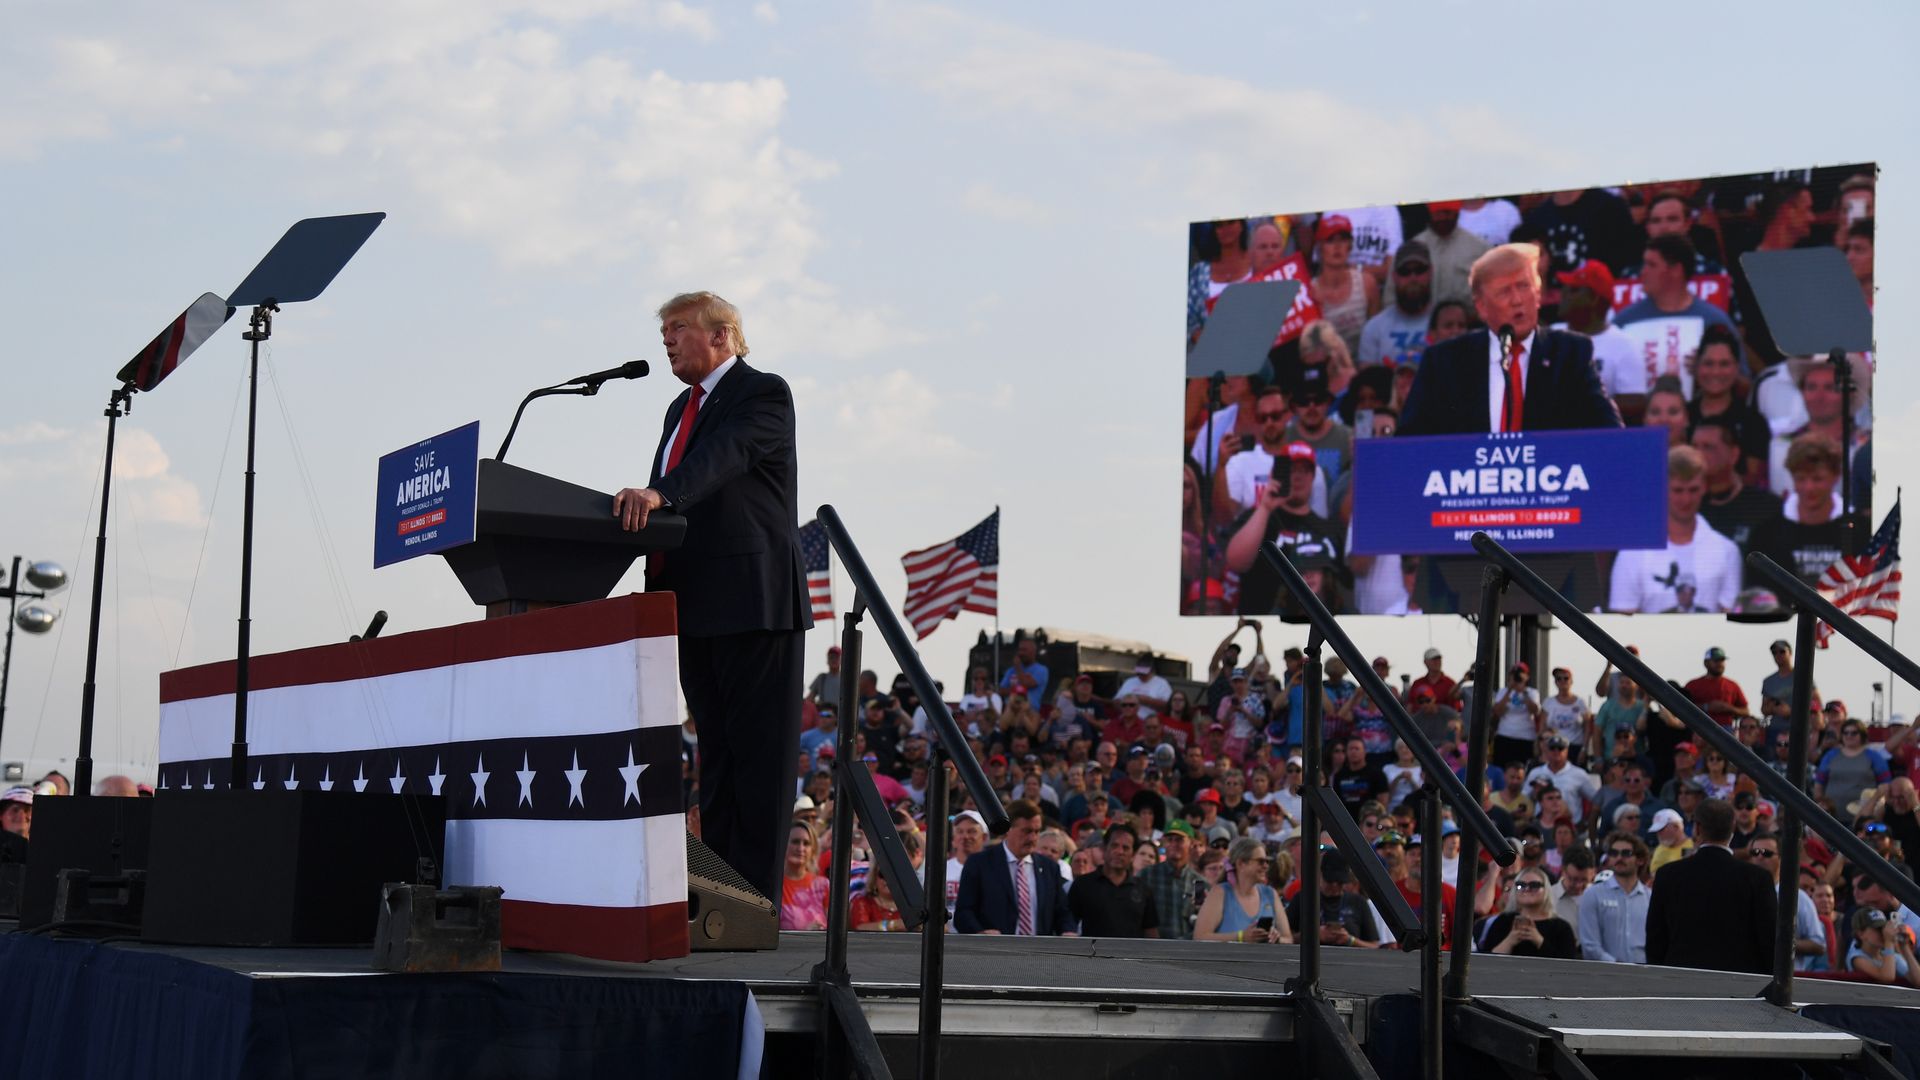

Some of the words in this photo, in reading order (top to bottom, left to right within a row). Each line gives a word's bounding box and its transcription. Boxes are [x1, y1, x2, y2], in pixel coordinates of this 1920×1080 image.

[414, 451, 435, 472] SAVE
[1475, 445, 1537, 466] SAVE
[396, 466, 450, 506] AMERICA
[1423, 463, 1590, 497] AMERICA
[1441, 498, 1489, 508] PRESIDENT
[1490, 496, 1527, 506] DONALD
[1530, 496, 1537, 505] J.
[1540, 494, 1570, 504] TRUMP
[401, 504, 418, 515] PRESIDENT
[401, 521, 410, 531] TEXT
[410, 517, 426, 529] ILLINOIS
[1441, 514, 1467, 523] TEXT
[1469, 512, 1516, 522] ILLINOIS
[1518, 512, 1534, 522] TO
[1535, 511, 1570, 521] 88022
[421, 530, 438, 541] ILLINOIS
[1507, 528, 1555, 540] ILLINOIS
